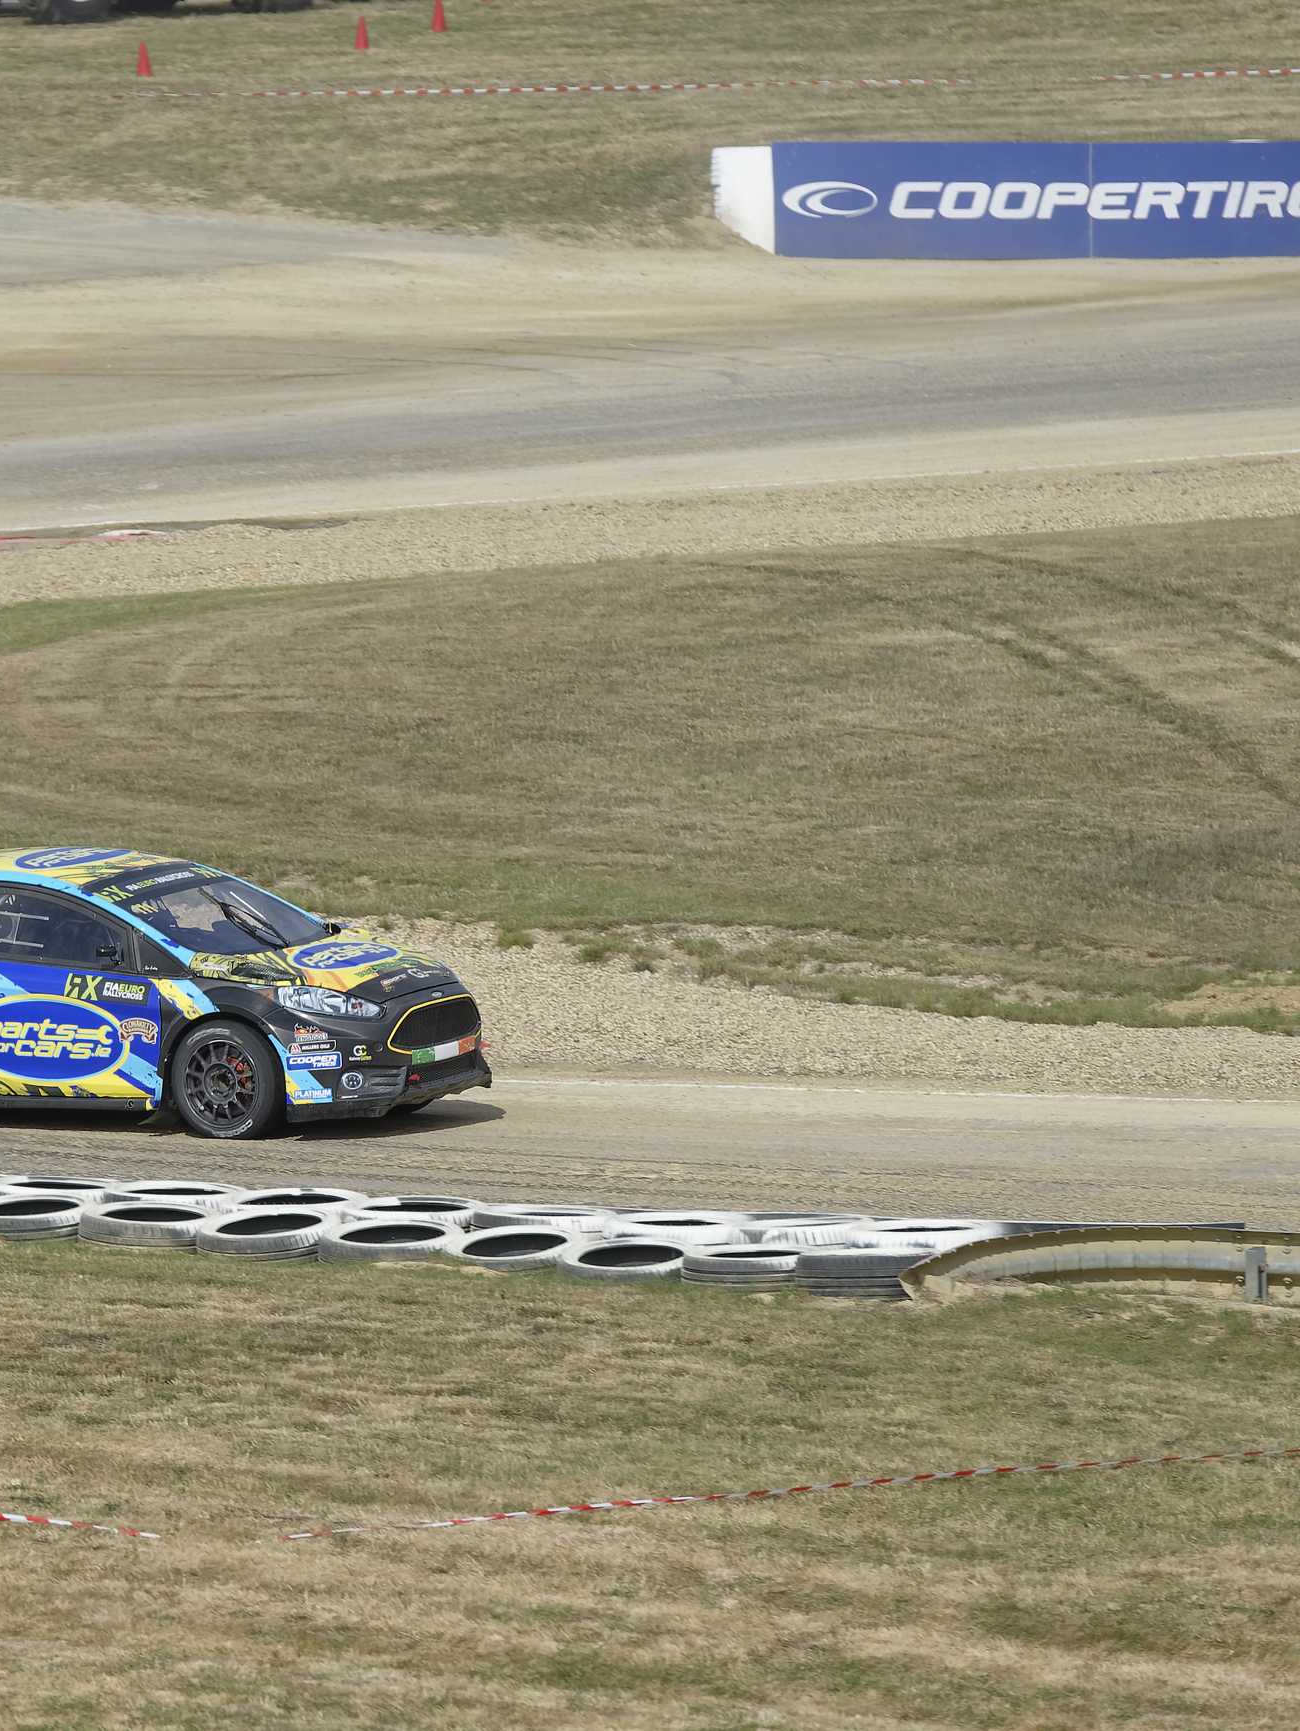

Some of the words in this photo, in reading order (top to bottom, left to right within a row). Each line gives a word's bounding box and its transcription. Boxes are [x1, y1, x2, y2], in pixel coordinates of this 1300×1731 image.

[102, 990, 144, 1001] RALLYCROSS
[288, 1054, 339, 1066] COOPER
[294, 1088, 332, 1100] PLATINUM
